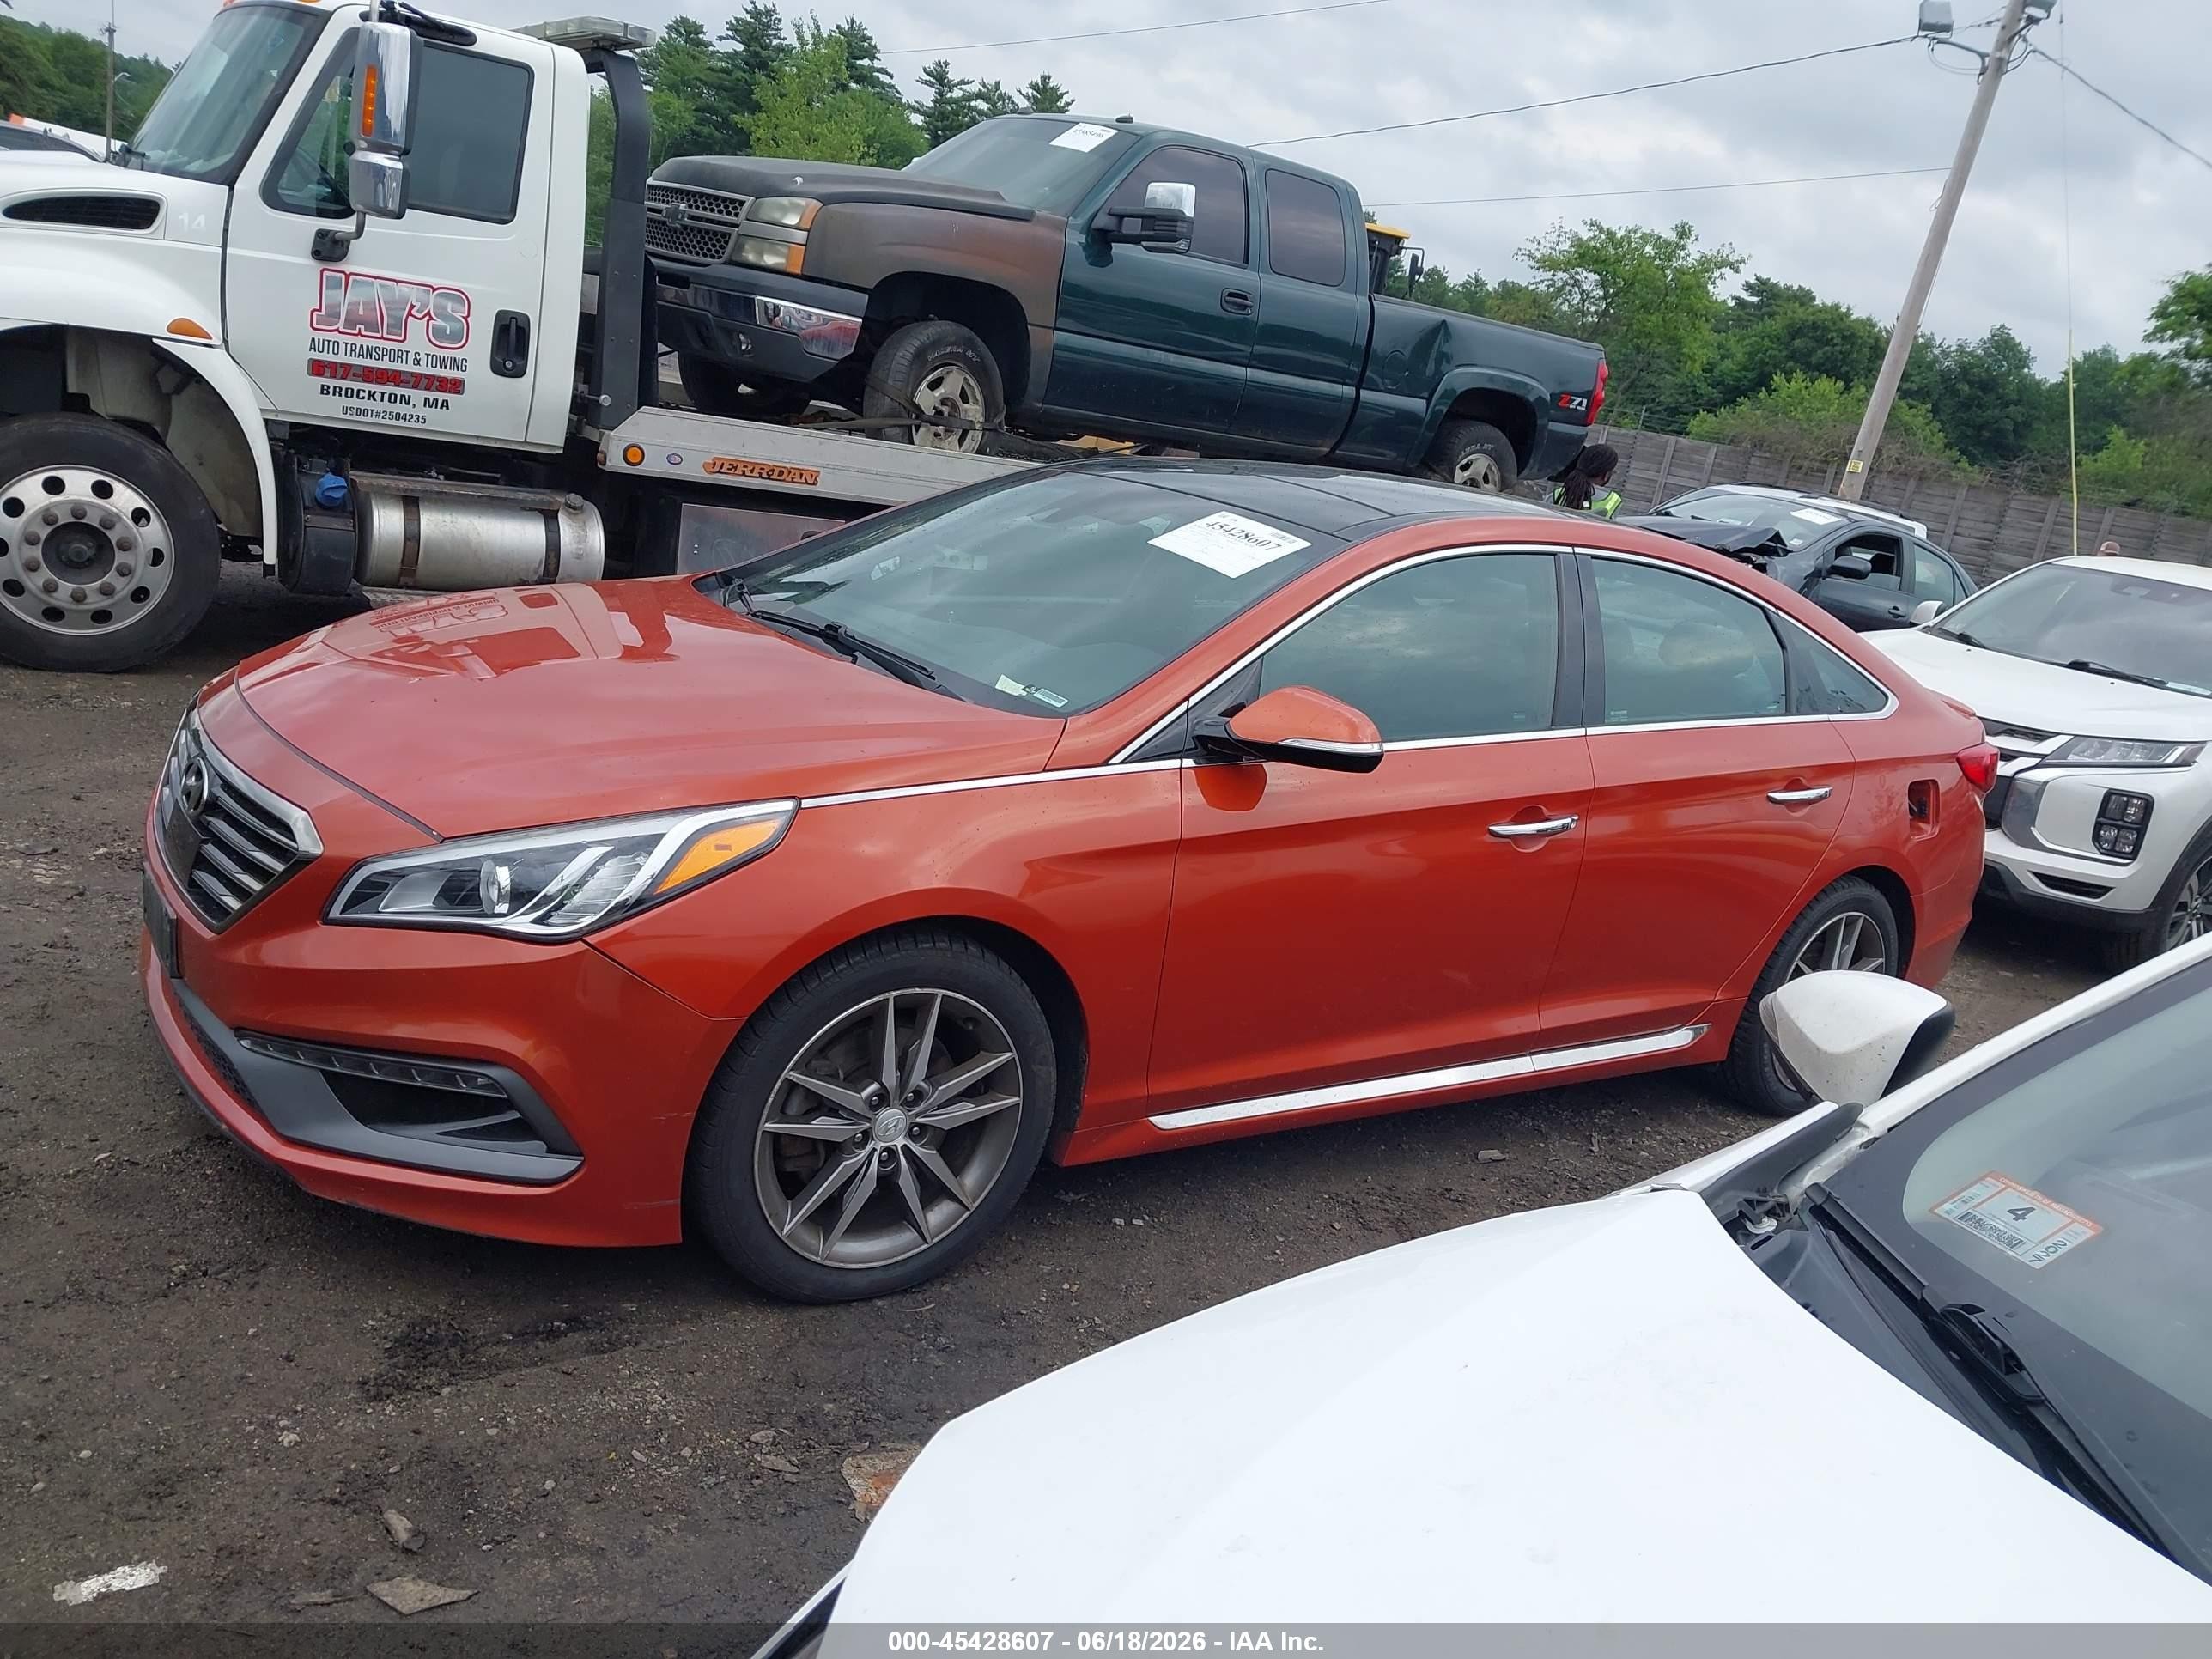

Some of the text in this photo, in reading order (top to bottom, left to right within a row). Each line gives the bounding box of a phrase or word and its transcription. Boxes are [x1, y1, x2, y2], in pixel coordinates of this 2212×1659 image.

[179, 212, 205, 232] 14
[311, 269, 471, 350] JAY'S
[309, 337, 468, 373] AUTO TRANSPORT & TOWING
[311, 361, 462, 394] 617-594-7732
[319, 384, 451, 410] BROCKTON, MA
[1558, 393, 1588, 411] Z71
[342, 405, 427, 424] USDOT#2504235
[1206, 520, 1282, 550] 45428607
[2006, 1205, 2037, 1223] 4
